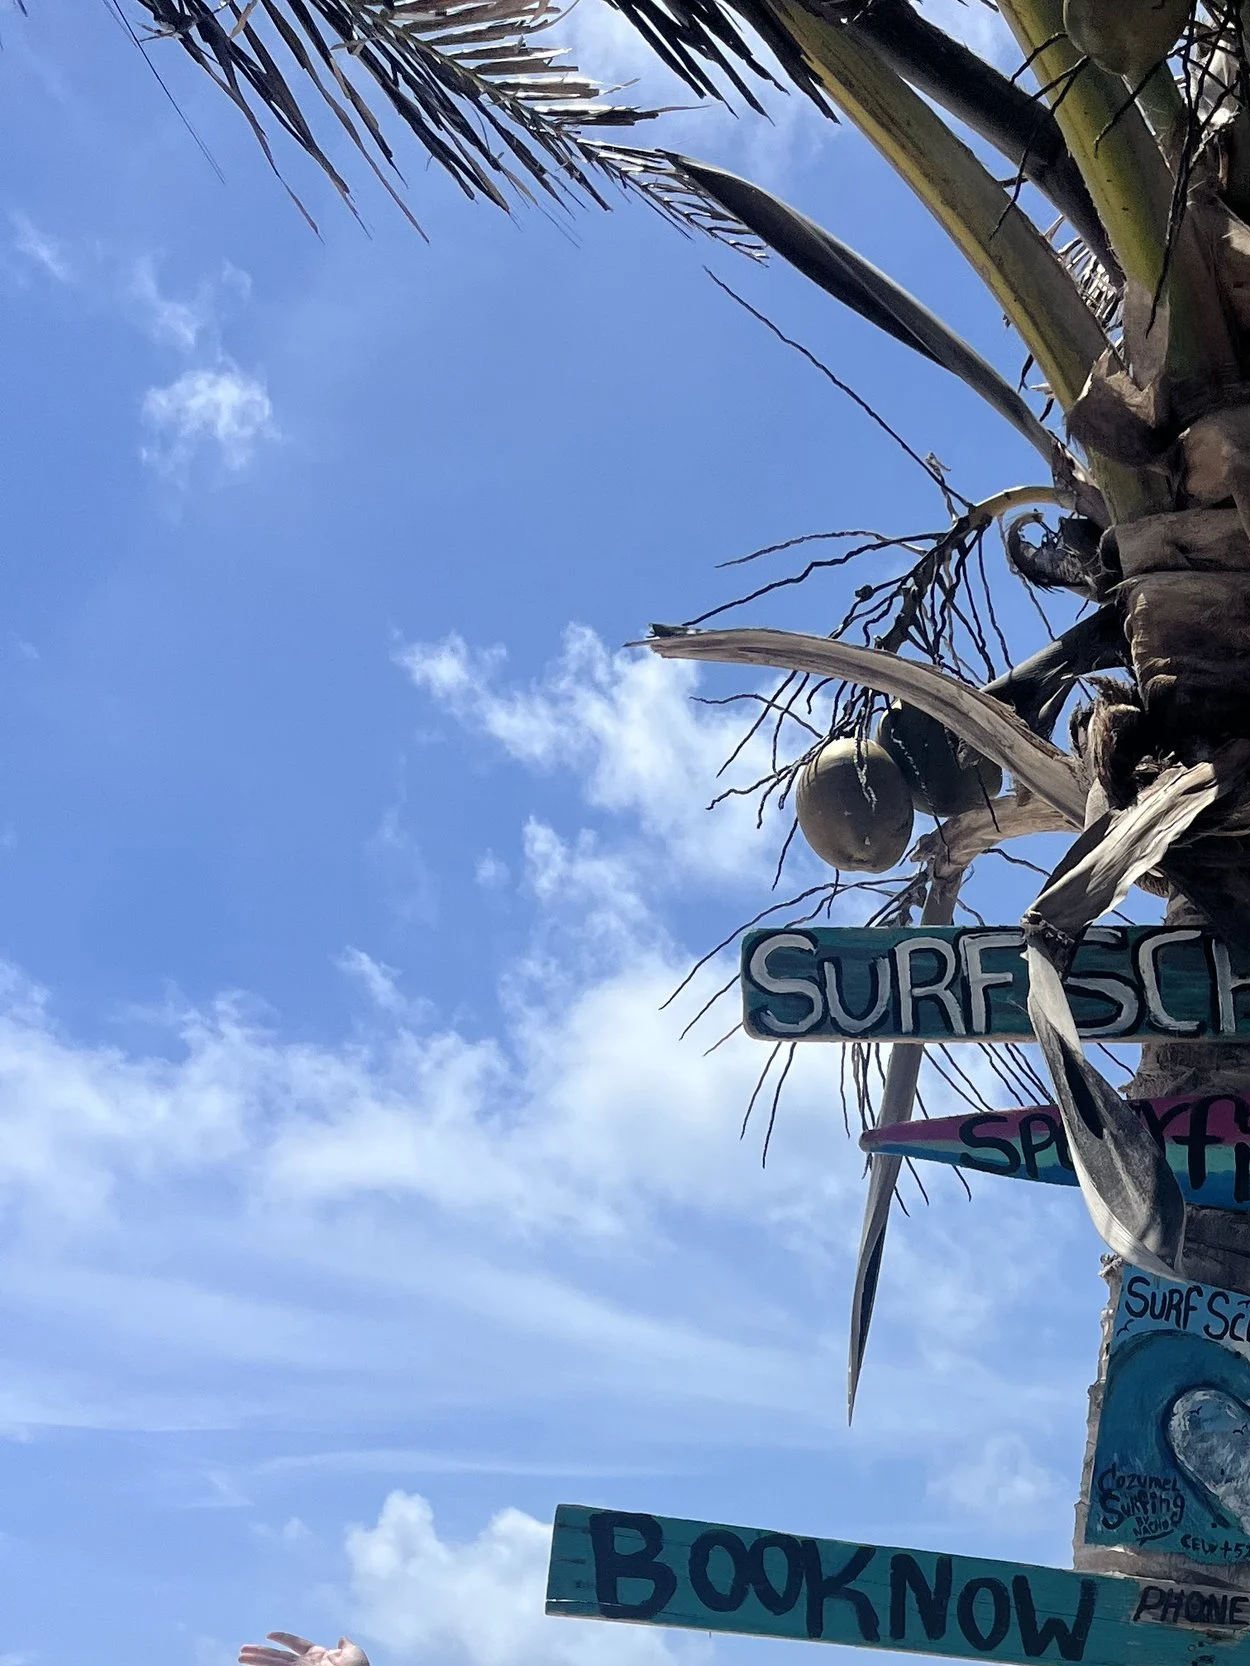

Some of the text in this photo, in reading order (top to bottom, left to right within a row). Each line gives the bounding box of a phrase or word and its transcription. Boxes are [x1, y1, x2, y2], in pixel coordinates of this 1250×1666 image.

[743, 928, 1027, 1037] SURF
[1125, 1275, 1204, 1329] SURF
[588, 1512, 1098, 1662] BOOK NOW
[1132, 1585, 1250, 1626] PHONE
